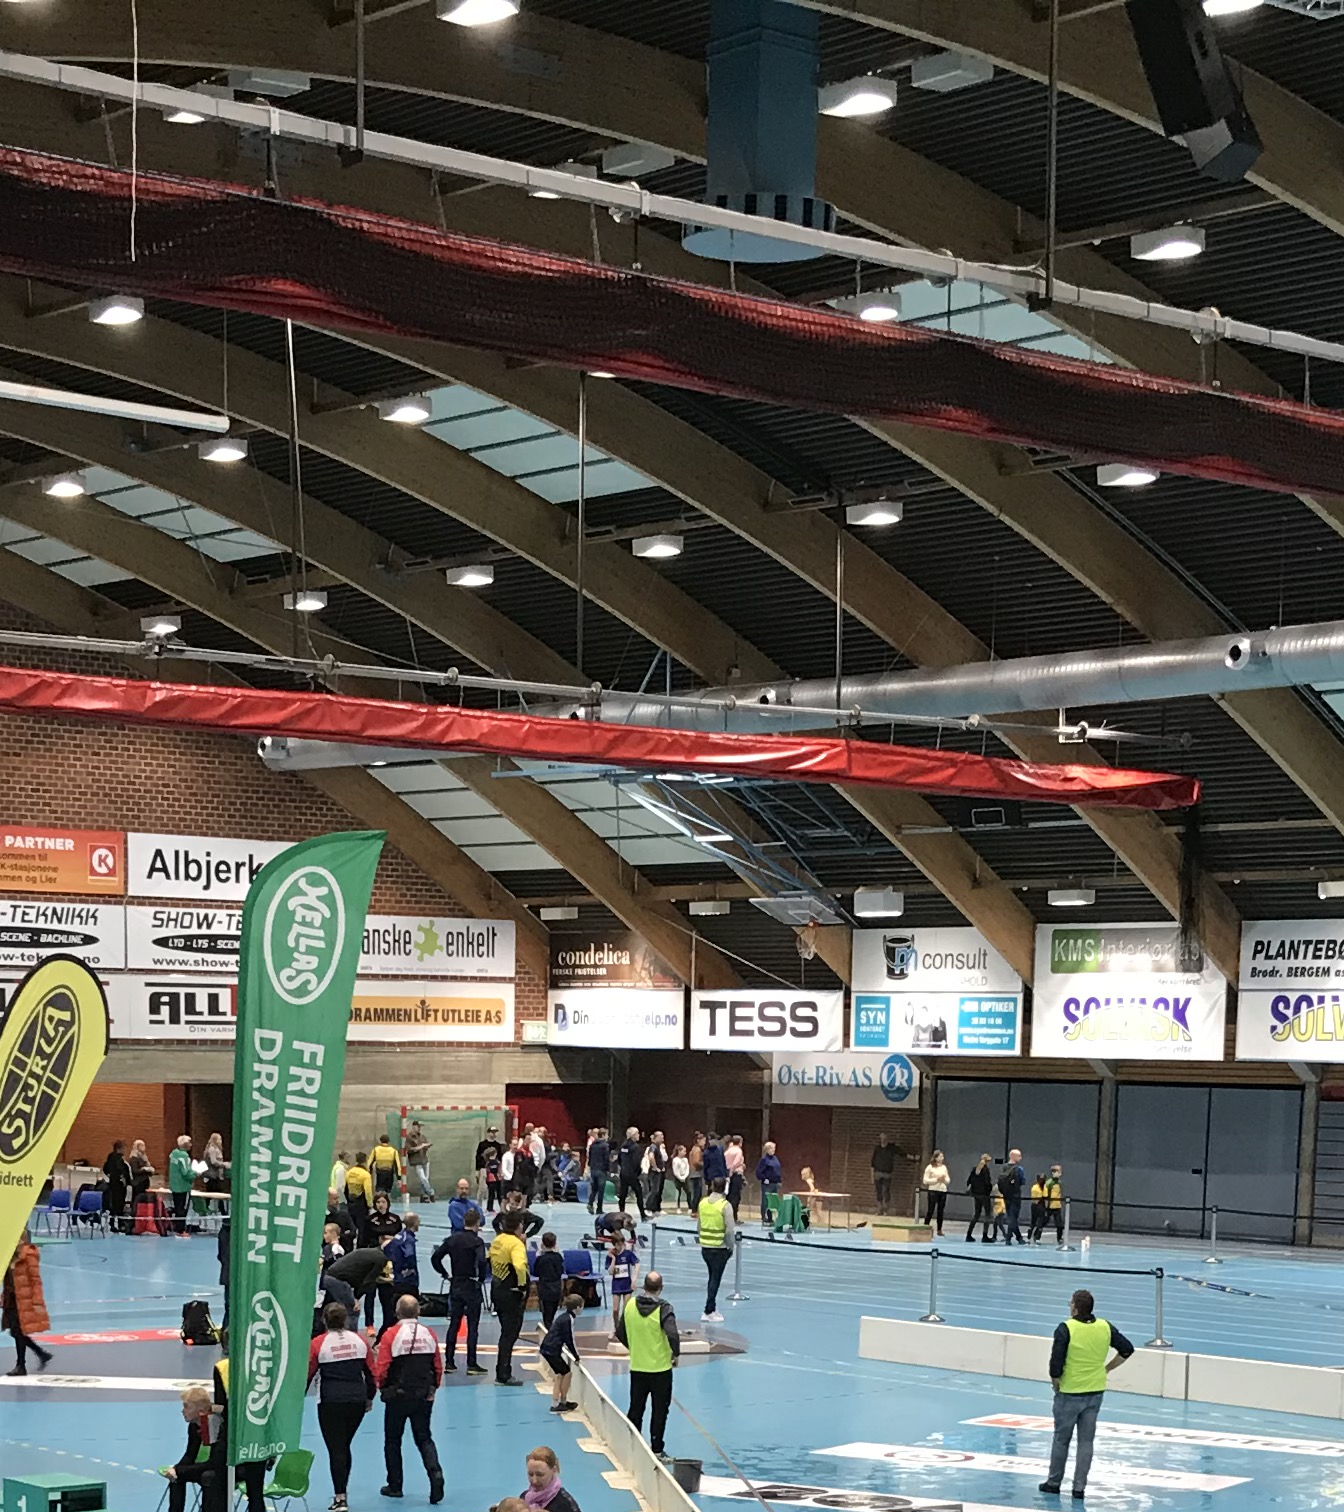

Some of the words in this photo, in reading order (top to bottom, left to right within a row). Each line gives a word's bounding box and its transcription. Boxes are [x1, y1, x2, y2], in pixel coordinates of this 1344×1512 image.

[5, 834, 75, 851] PARTNER
[38, 852, 48, 862] til
[0, 862, 59, 876] K-stasjonene
[25, 874, 38, 885] og
[40, 873, 58, 884] Lier
[0, 932, 31, 943] SCENE
[40, 933, 84, 944] BACKLINE
[168, 938, 184, 948] LYD
[193, 939, 209, 949] LYS
[217, 939, 240, 949] SCEN
[362, 923, 412, 956] anske
[446, 925, 497, 958] enkelt
[558, 943, 630, 965] condelica
[1055, 938, 1095, 962] KMS
[152, 957, 240, 968] www.show-t
[922, 947, 988, 970] consult
[1286, 966, 1331, 978] BERGEM
[442, 1009, 481, 1024] UTLEIE
[699, 1000, 819, 1038] TESS
[860, 1010, 886, 1024] SYN
[189, 1025, 206, 1033] DIN
[209, 1026, 235, 1034] VARM
[777, 1064, 841, 1087] Øst-Riv
[849, 1066, 872, 1088] AS
[247, 1028, 283, 1264] DRAMMEN
[272, 1040, 325, 1263] FRIIDRETT
